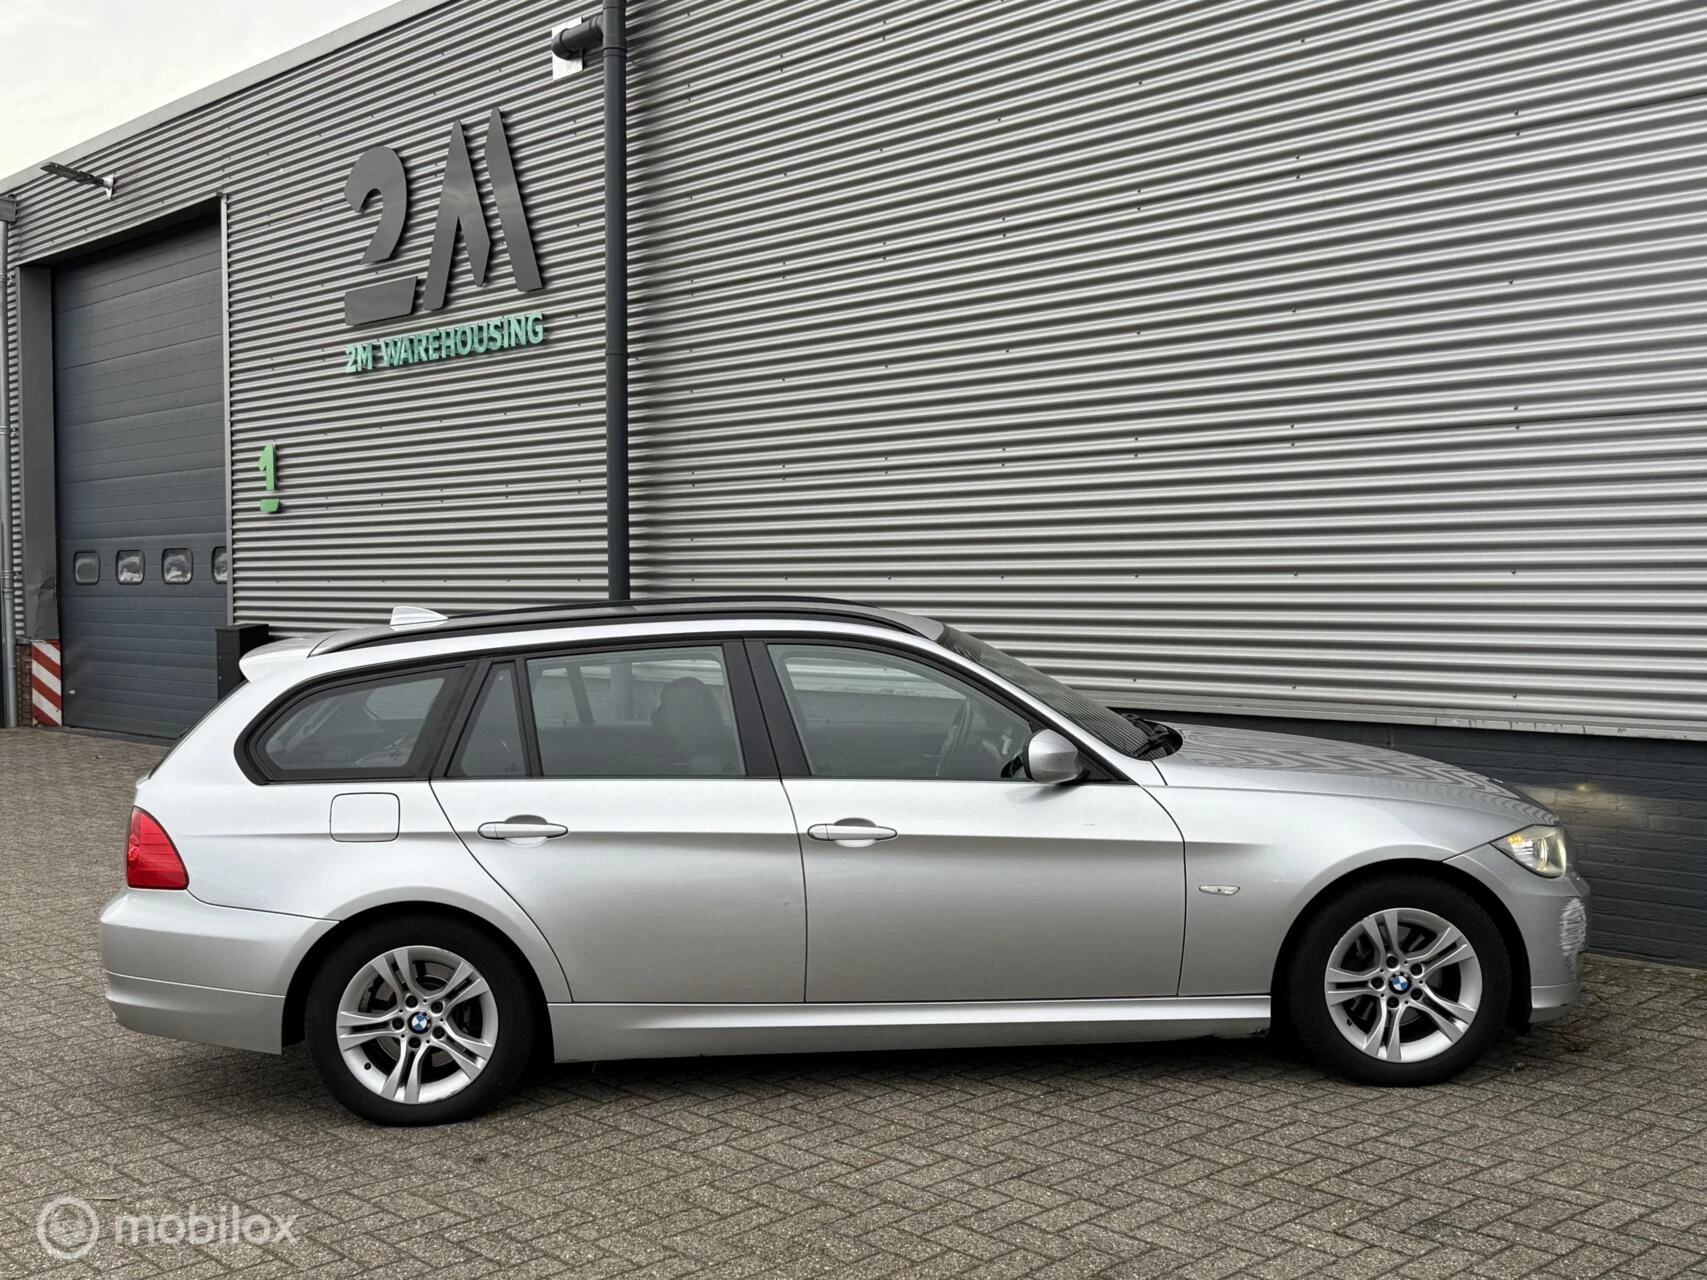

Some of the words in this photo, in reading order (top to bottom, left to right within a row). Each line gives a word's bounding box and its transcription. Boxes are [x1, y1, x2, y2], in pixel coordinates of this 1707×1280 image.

[344, 107, 543, 326] 2M
[345, 343, 373, 373] 2M
[381, 311, 544, 367] WAREHOUSING
